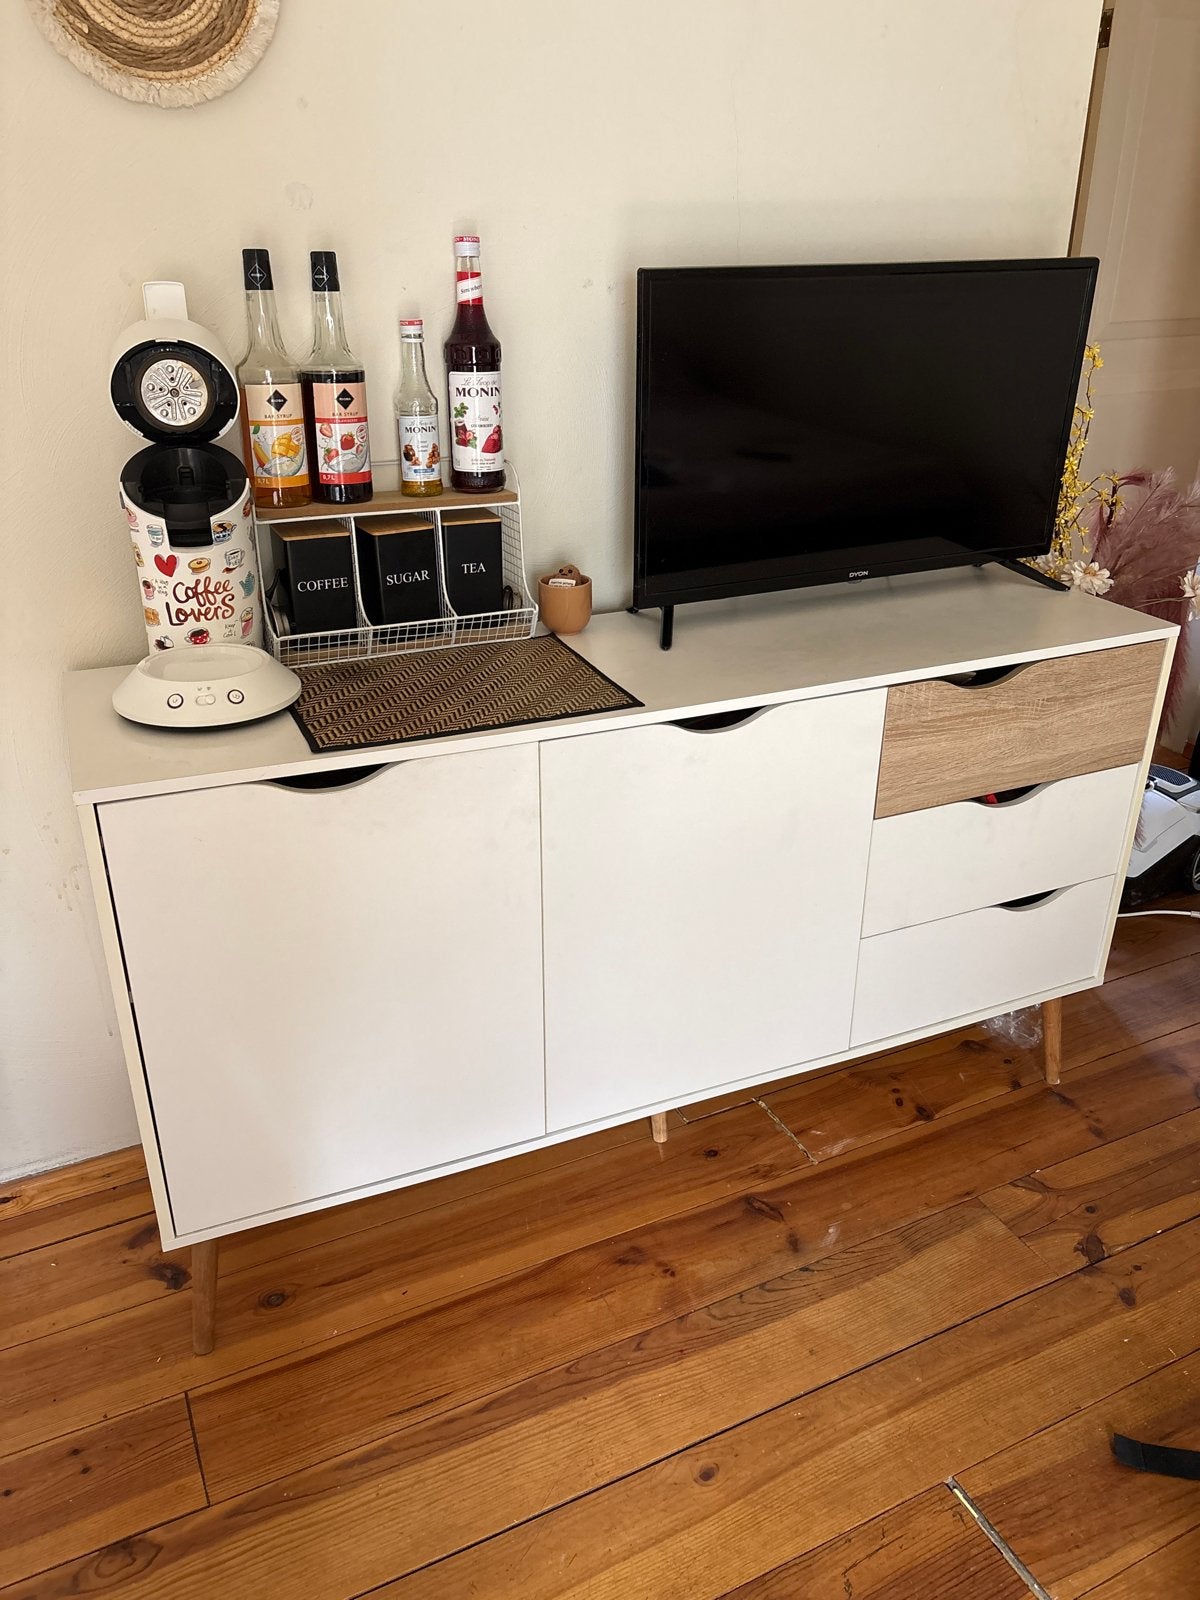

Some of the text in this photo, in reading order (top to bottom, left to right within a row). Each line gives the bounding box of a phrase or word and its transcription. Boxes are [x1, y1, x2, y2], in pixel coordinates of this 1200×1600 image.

[455, 386, 500, 398] MONIN
[404, 425, 436, 434] MONIN
[461, 562, 486, 574] TEA
[849, 570, 869, 578] DYON
[386, 569, 431, 586] SUGAR
[297, 576, 349, 592] COFFEE
[173, 576, 234, 607] Coffee
